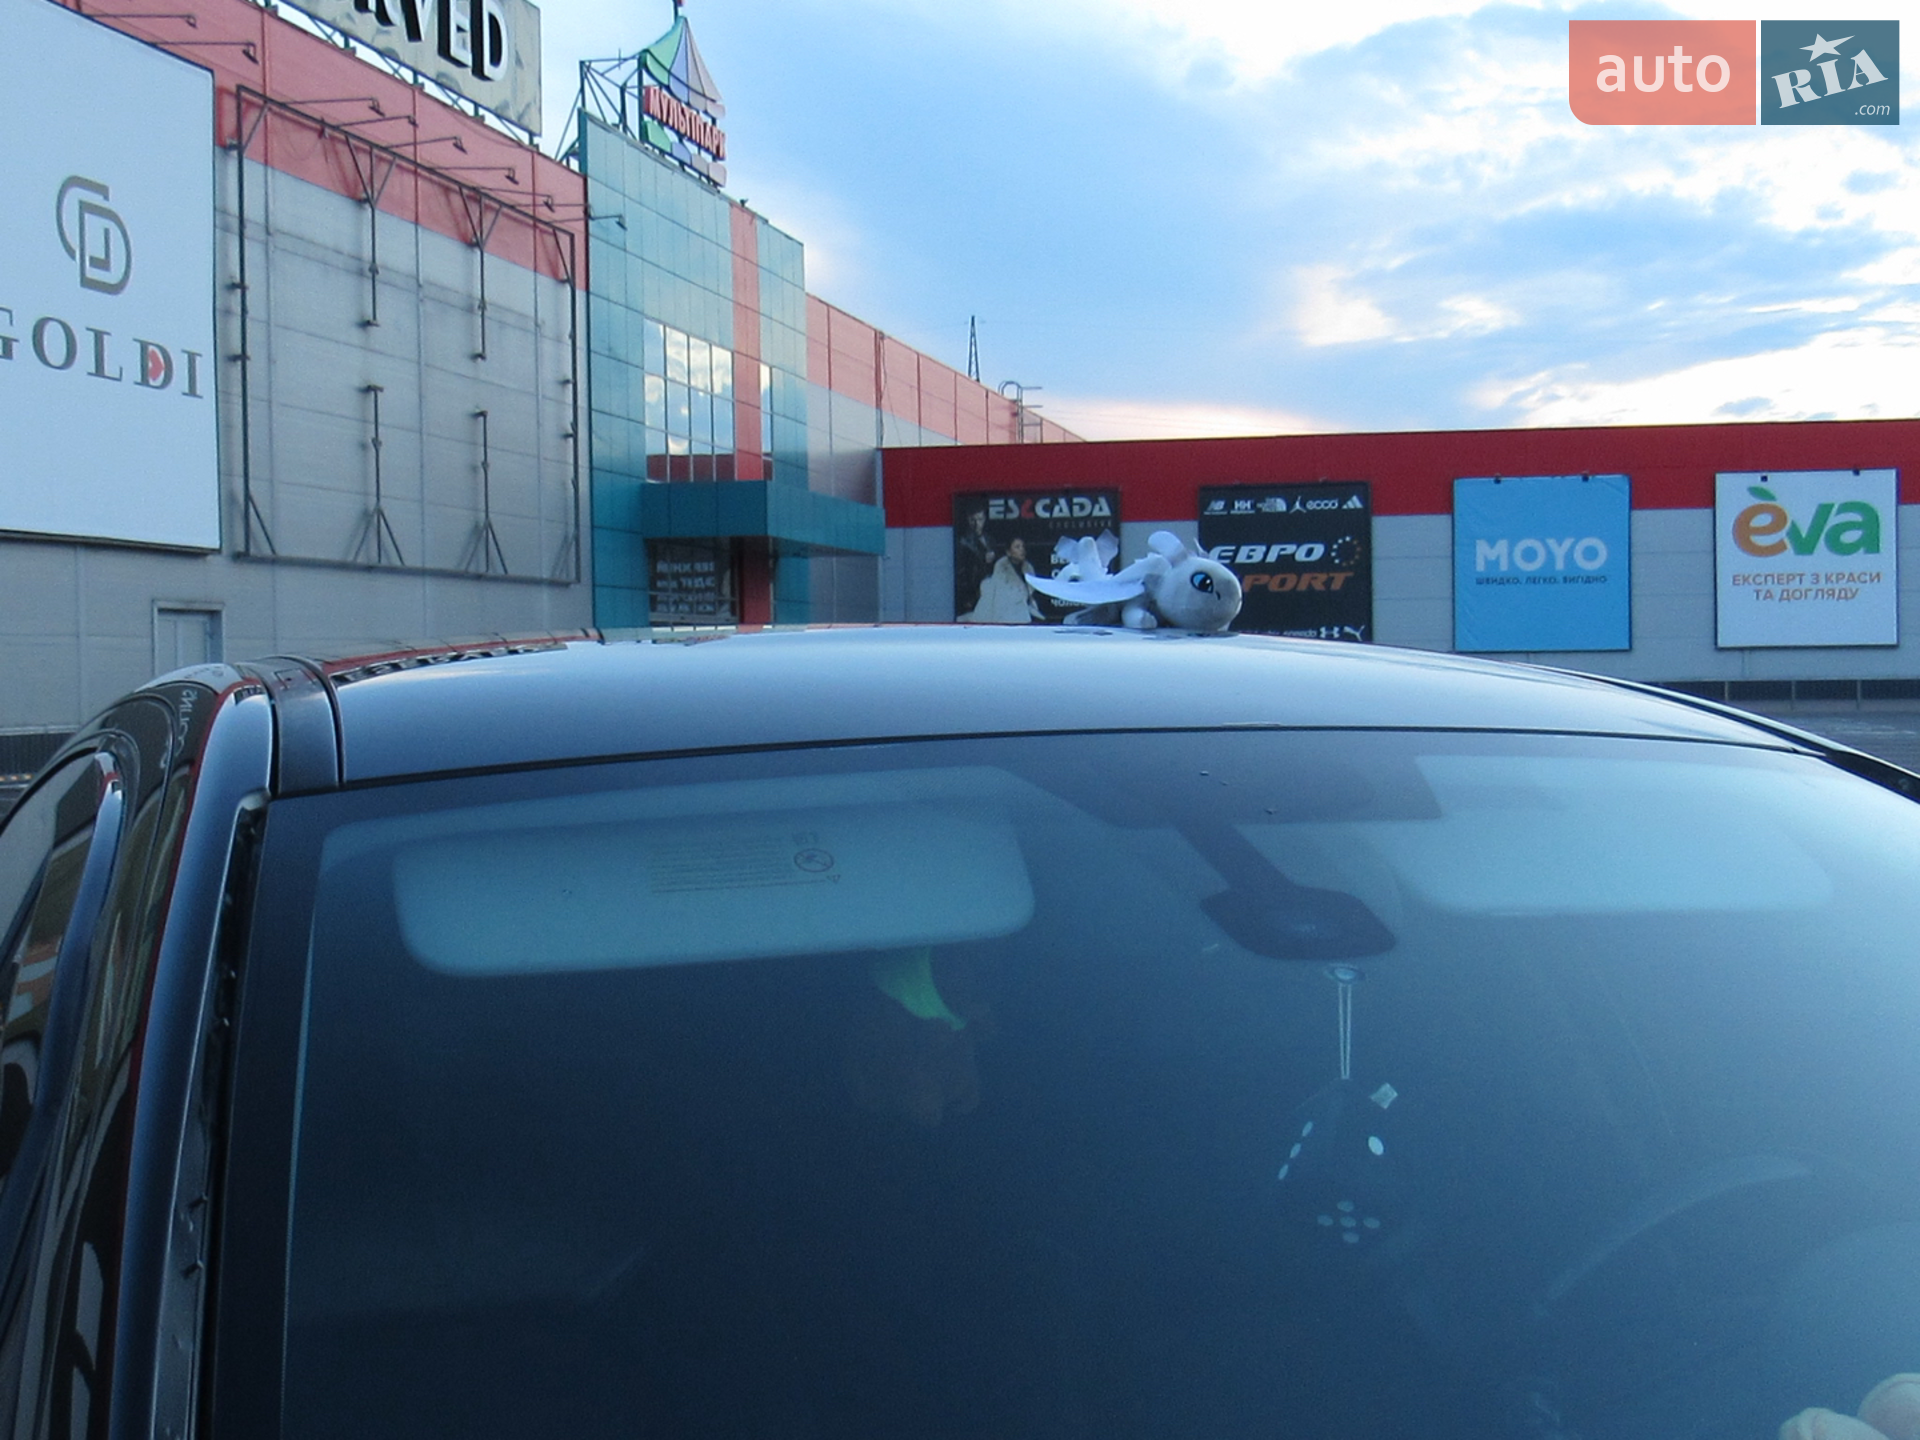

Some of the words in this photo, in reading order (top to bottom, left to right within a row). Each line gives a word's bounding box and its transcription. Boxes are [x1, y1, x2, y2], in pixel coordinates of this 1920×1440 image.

[1475, 537, 1608, 572] MOYO
[1242, 571, 1355, 593] PORT
[1731, 572, 1805, 586] ЕКСПЕРТ
[1824, 571, 1882, 585] КРАСИ
[1753, 588, 1775, 601] ТА
[1778, 587, 1860, 603] ДОГЛЯДУ
